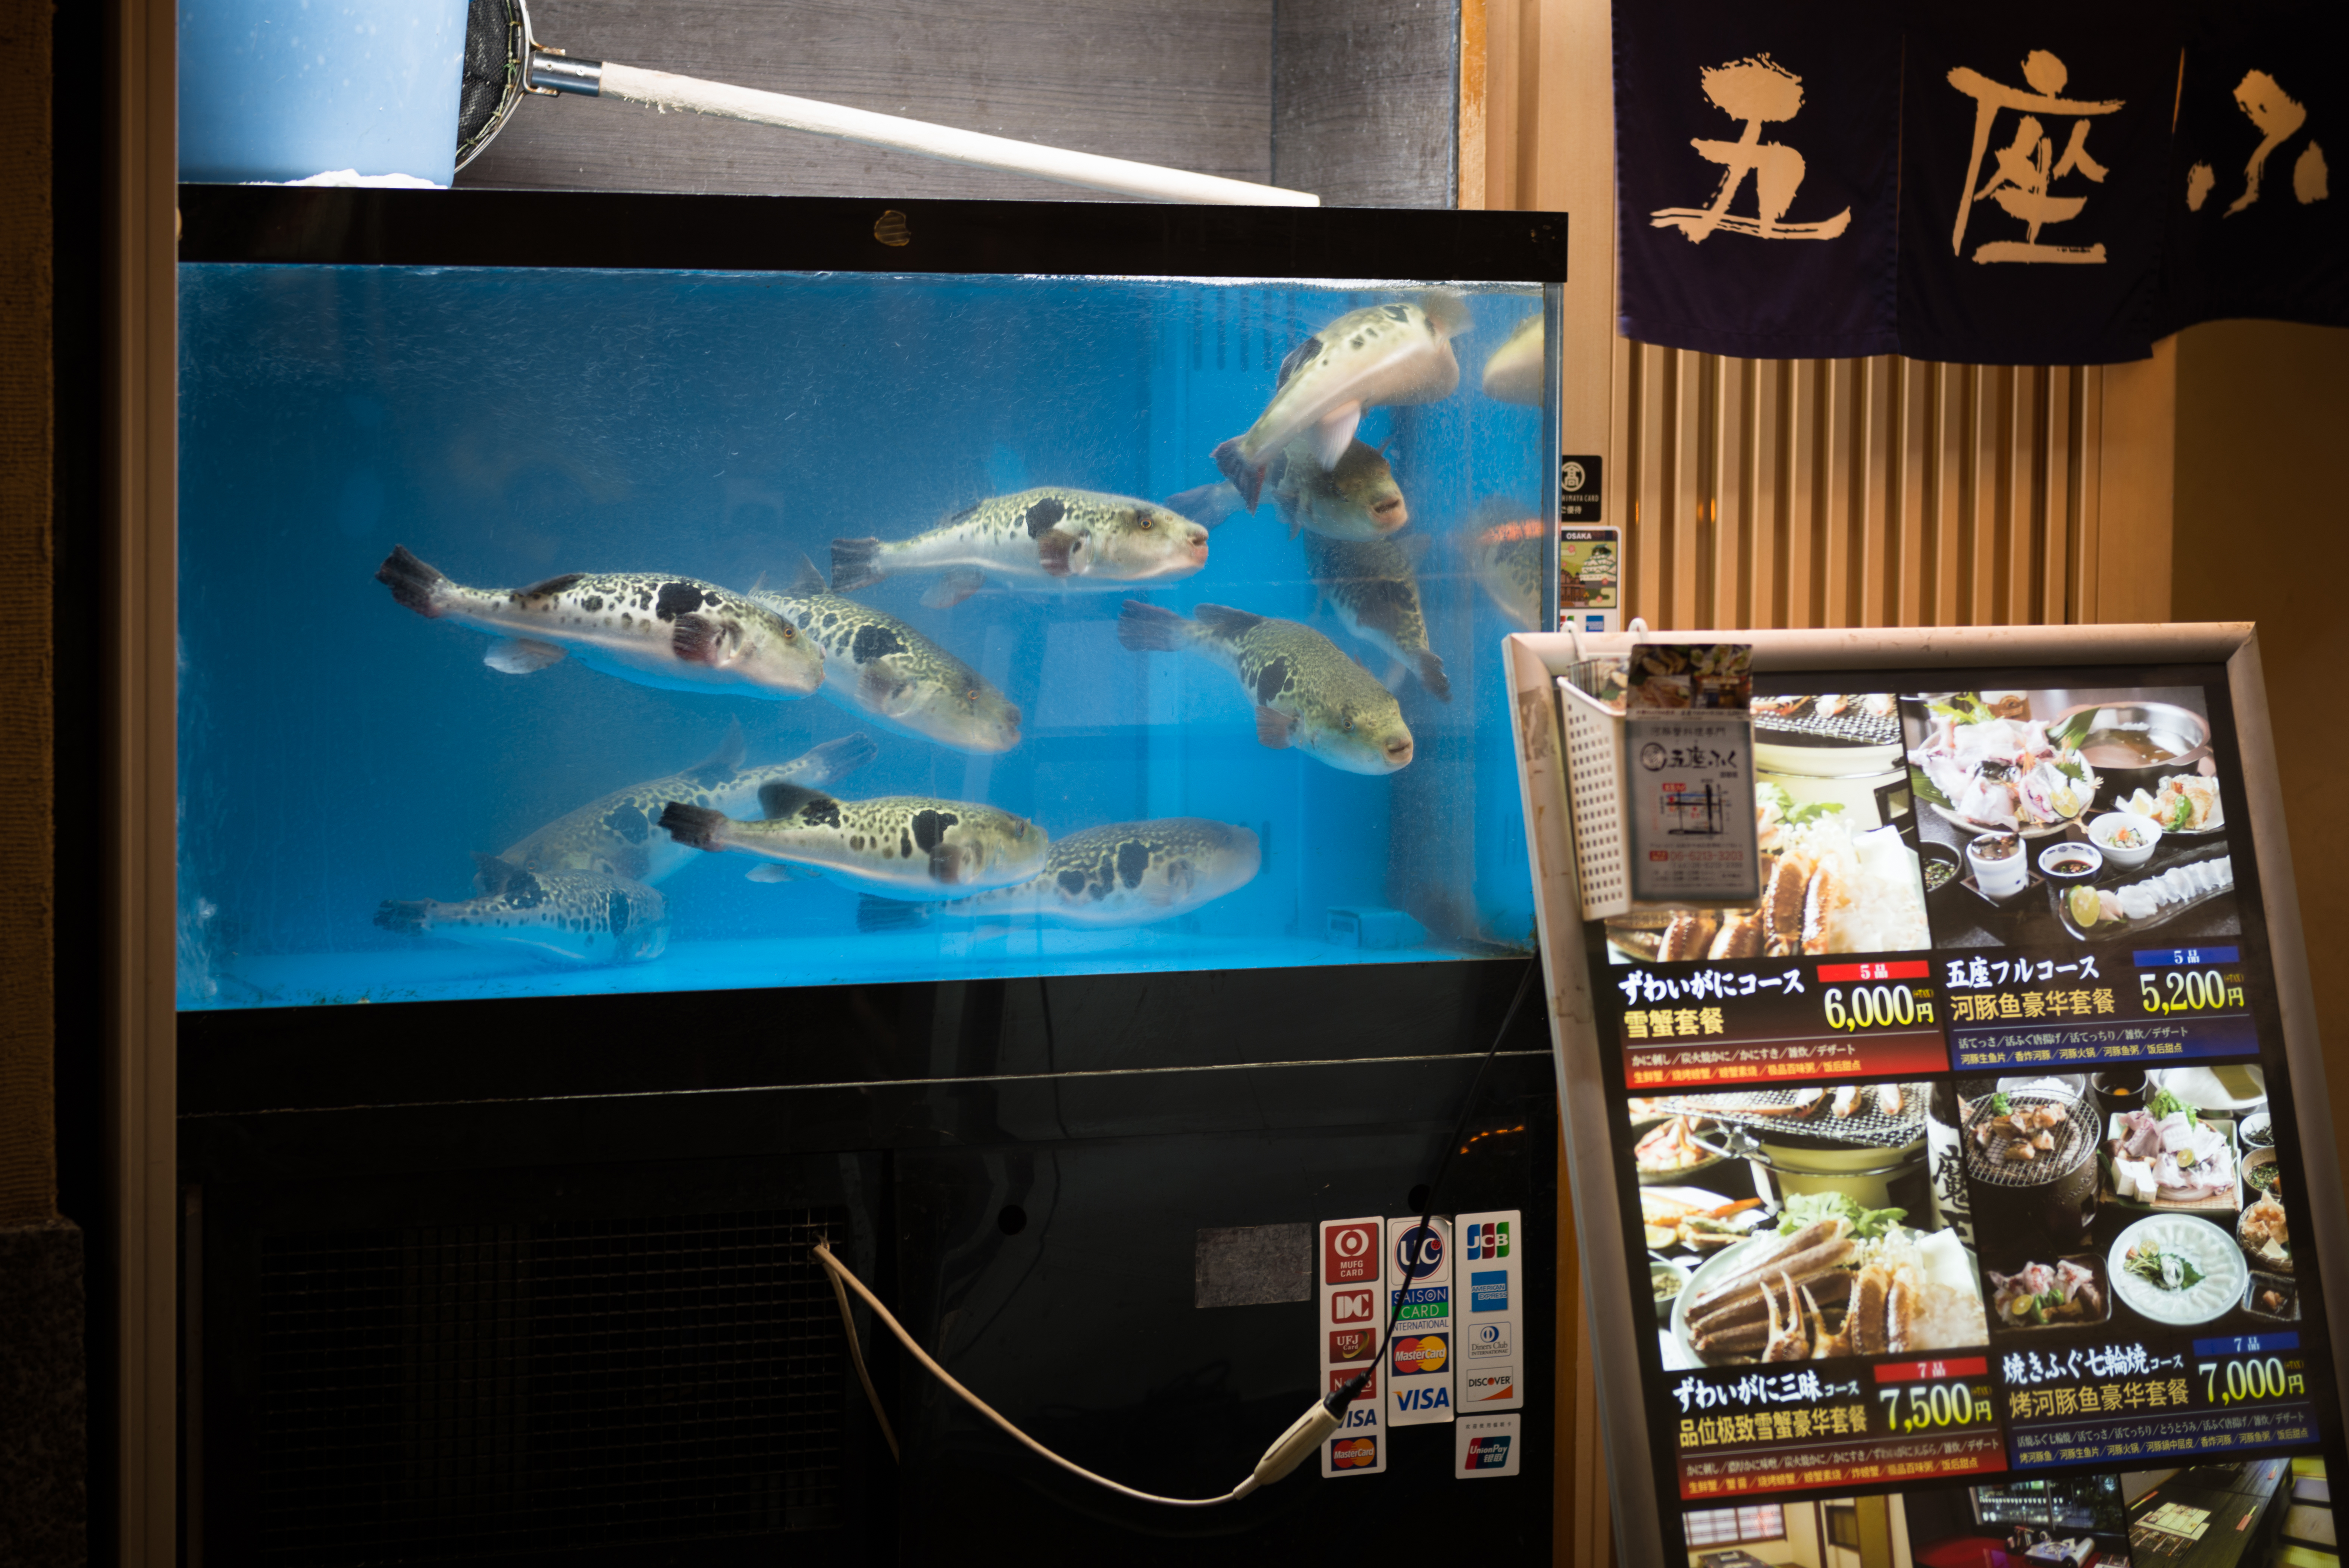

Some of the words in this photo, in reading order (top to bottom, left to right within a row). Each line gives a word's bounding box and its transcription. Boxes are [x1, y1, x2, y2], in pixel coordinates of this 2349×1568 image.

[1946, 955, 2100, 989] 五座フルコース
[1618, 968, 1805, 1006] ずわいがにコース
[1950, 988, 2115, 1021] 河豚鱼豪华套餐
[1624, 1007, 1724, 1039] 雪蟹套餐
[1400, 1237, 1440, 1265] UC
[1340, 1260, 1363, 1269] MUFG
[1340, 1269, 1363, 1277] CARD
[1471, 1283, 1506, 1293] AMERICAN
[1478, 1291, 1507, 1300] EXPRESS
[1394, 1288, 1446, 1305] SAISON
[1336, 1294, 1369, 1320] DC
[1401, 1304, 1440, 1319] CARD
[1393, 1319, 1449, 1332] NTERNATIONAL
[1337, 1335, 1359, 1346] UFJ
[1493, 1341, 1508, 1349] Club
[1395, 1348, 1446, 1362] MasterCard
[2002, 1343, 2184, 1385] 焼きふぐ七輪焼コース
[1469, 1376, 1511, 1387] DISCOVER
[1673, 1369, 1861, 1413] ずわいがに三昧コース
[2009, 1378, 2190, 1419] 烤河豚鱼豪华套餐
[1392, 1387, 1450, 1411] VISA
[1679, 1404, 1867, 1448] 品位极致雪蟹豪华套餐
[1334, 1447, 1375, 1459] MasterCard
[1470, 1444, 1508, 1455] UnionPay
[1484, 1453, 1504, 1463] 银联
